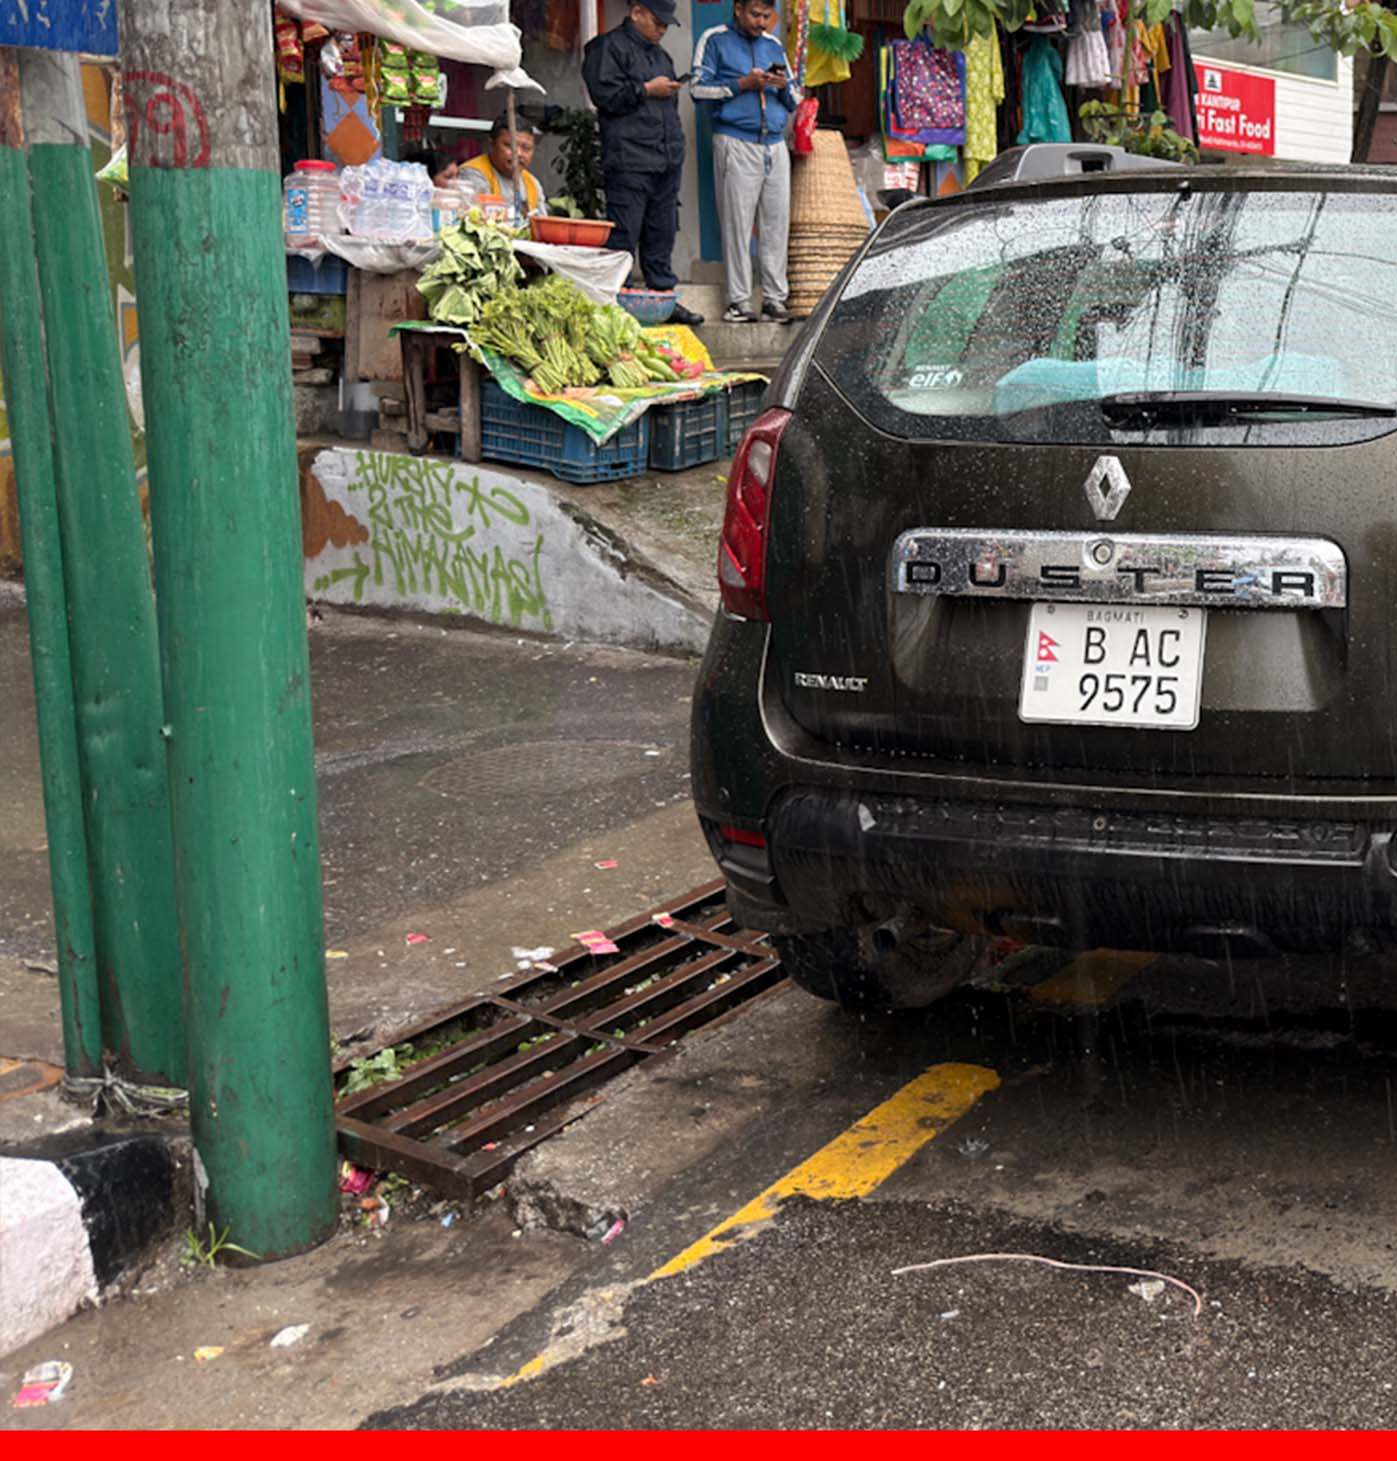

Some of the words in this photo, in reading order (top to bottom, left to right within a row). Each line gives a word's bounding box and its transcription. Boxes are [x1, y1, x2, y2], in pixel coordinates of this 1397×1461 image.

[1208, 110, 1235, 134] Fast
[1239, 114, 1271, 139] Food
[906, 560, 1315, 597] DUSTER
[1087, 610, 1145, 624] BAGMATI
[1083, 626, 1107, 665] B
[1129, 628, 1181, 668] AC
[794, 671, 869, 692] RENAULT
[1078, 672, 1179, 714] 9575
